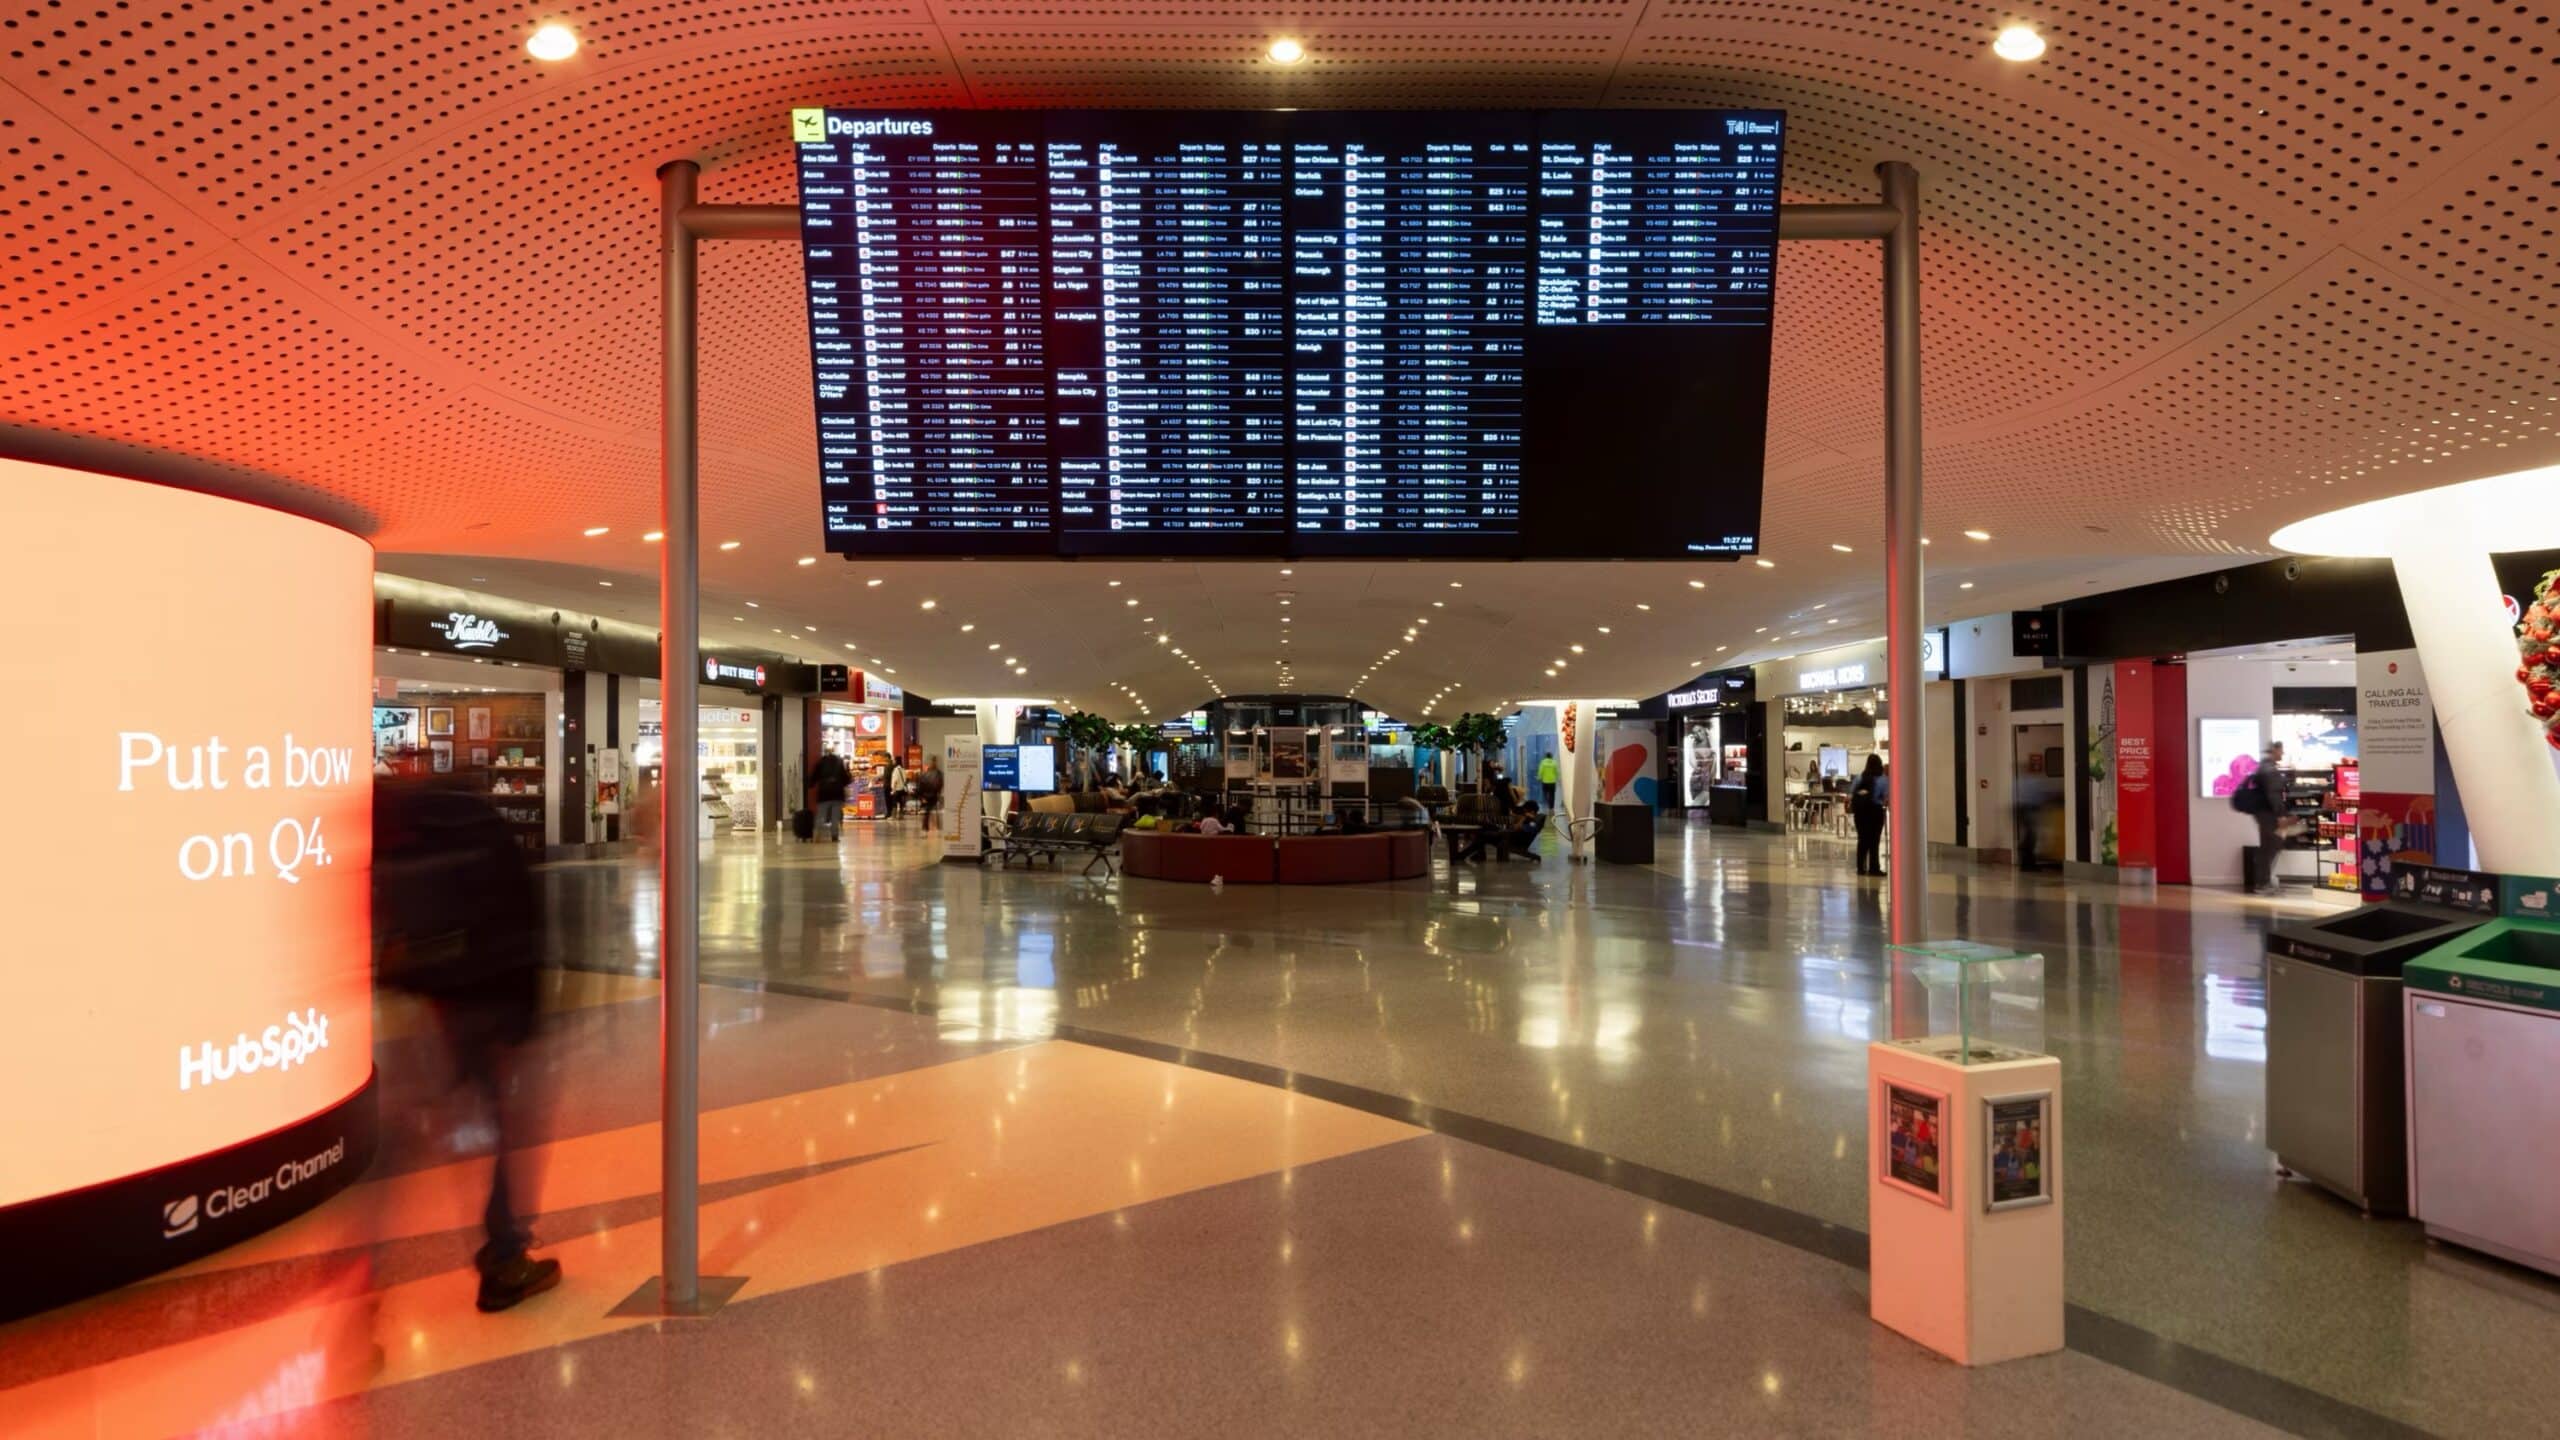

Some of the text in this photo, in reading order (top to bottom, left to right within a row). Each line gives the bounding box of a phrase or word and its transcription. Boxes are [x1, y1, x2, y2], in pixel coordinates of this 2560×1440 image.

[827, 117, 933, 139] Departures
[852, 143, 870, 151] Flight
[1346, 144, 1364, 152] Flight
[1050, 187, 1086, 196] Green Bay
[1295, 188, 1323, 196] Orlando
[1541, 188, 1574, 196] Syracuse
[1051, 203, 1092, 212] Indianapolis
[807, 218, 832, 226] Atlanta
[1540, 220, 1563, 228] Tampa
[1296, 235, 1338, 244] Panama City
[1052, 250, 1093, 259] Kansas City
[1539, 251, 1560, 259] Tokyo
[1053, 266, 1083, 275] Kingston
[811, 281, 836, 289] Bangor
[1066, 282, 1088, 290] Vegas
[1319, 298, 1339, 306] Spain
[1067, 312, 1097, 321] Angeles
[1555, 316, 1577, 324] Beach
[816, 342, 851, 351] Burlington
[1296, 344, 1322, 352] Raleigh
[1057, 373, 1087, 381] Memphis
[819, 384, 847, 393] Chicago
[1082, 388, 1096, 396] City
[1328, 419, 1342, 427] City
[1061, 462, 1100, 470] Minneapolis
[1061, 477, 1095, 485] Monterrey
[829, 516, 843, 524] Fort
[445, 612, 498, 642] Kiehl's
[1800, 664, 1865, 689] MICHAEL KORS
[2364, 688, 2424, 699] CALLING ALL
[1667, 688, 1718, 708] VICTORIA'S SECRET
[2368, 698, 2421, 709] TRAVELERS
[2121, 738, 2145, 746] BEST
[2119, 747, 2150, 755] PRICE
[118, 732, 352, 792] Put a bow
[178, 817, 332, 884] on Q4.
[180, 1008, 329, 1091] HubSpot
[206, 1137, 344, 1220] Clear Channel
